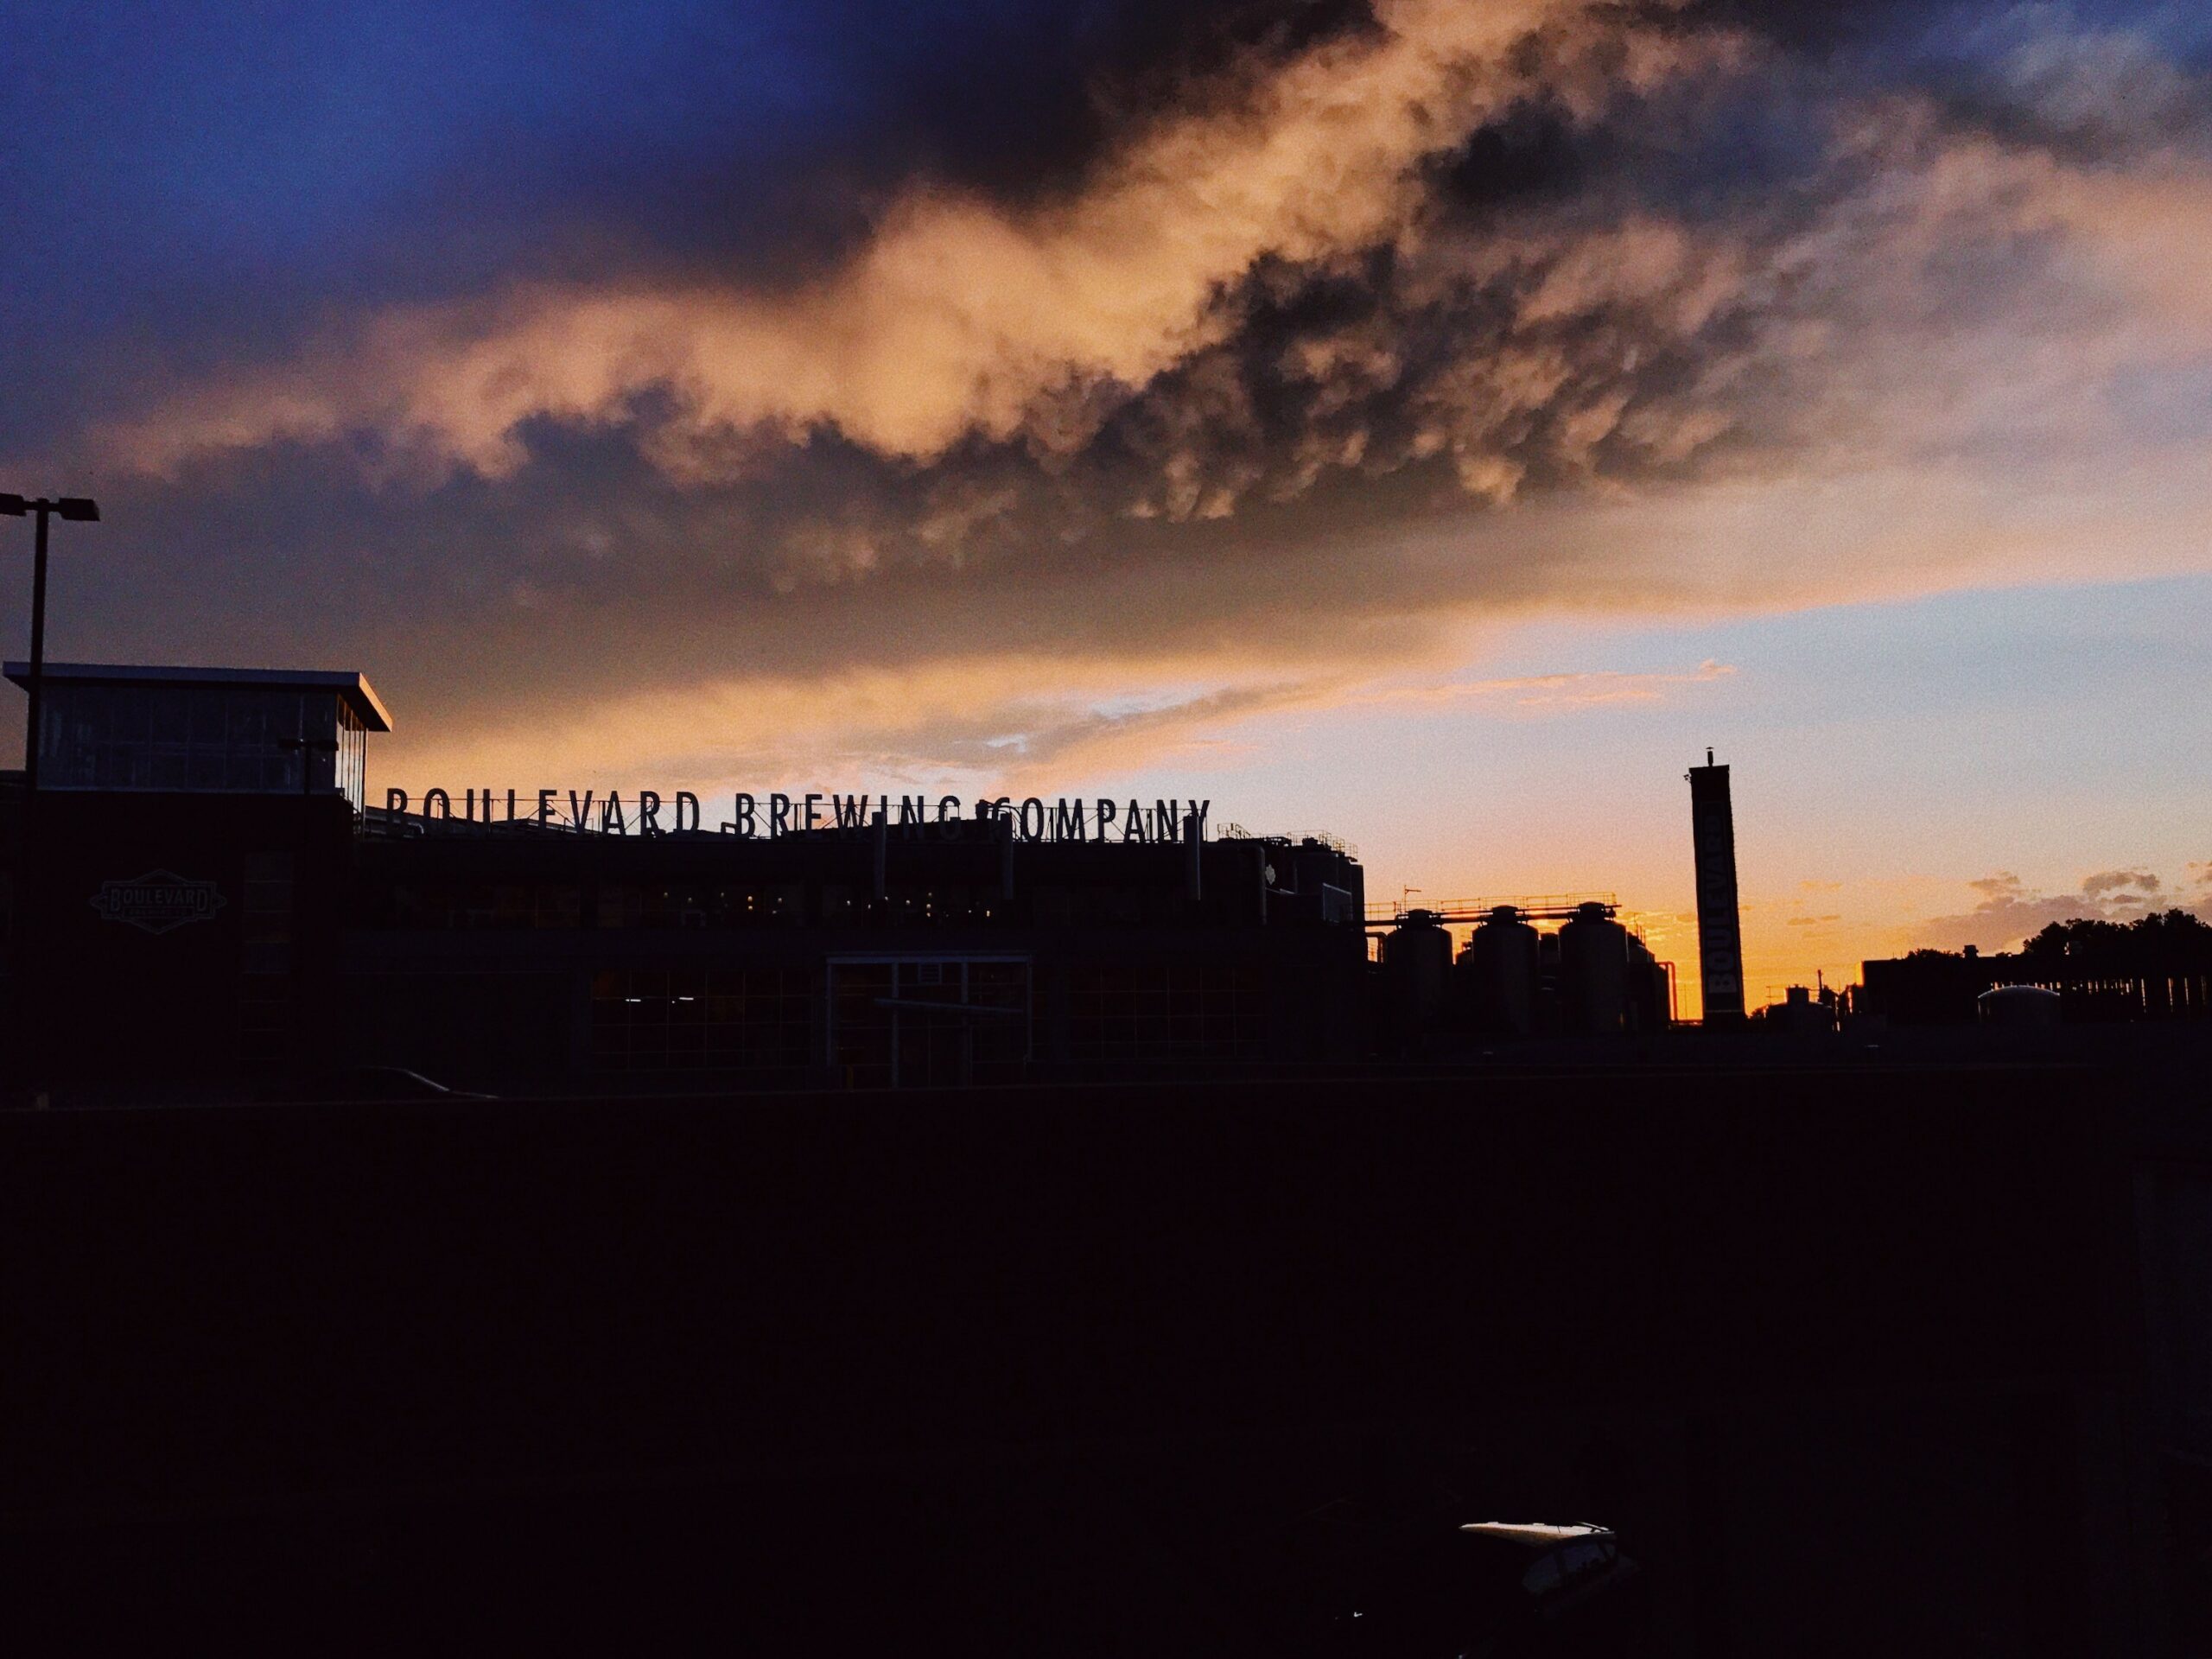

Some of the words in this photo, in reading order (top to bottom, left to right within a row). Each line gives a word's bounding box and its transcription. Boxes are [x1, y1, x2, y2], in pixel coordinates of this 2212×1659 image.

[386, 788, 700, 838] BOULEVARD
[110, 888, 207, 912] BOULEVARD
[1702, 815, 1737, 992] BOULEVARD
